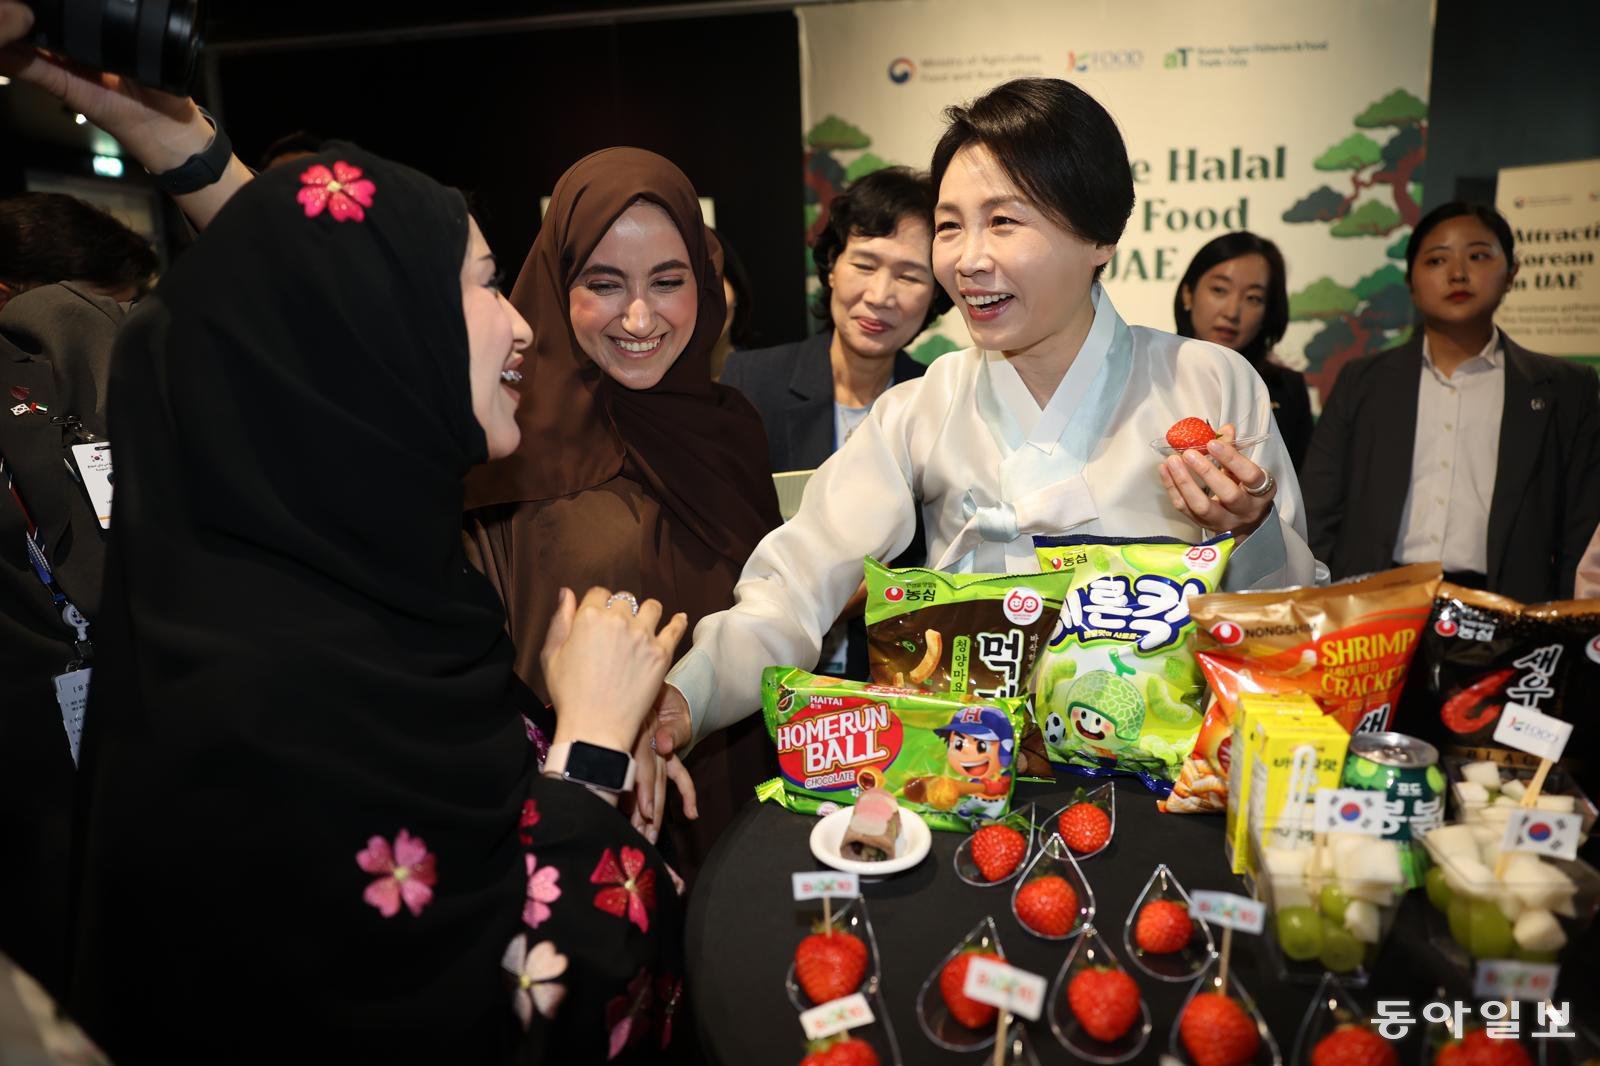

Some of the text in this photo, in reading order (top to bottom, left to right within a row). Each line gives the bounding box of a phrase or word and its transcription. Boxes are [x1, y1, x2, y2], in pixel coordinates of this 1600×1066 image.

[1167, 146, 1286, 182] Halal
[1142, 197, 1248, 232] Food
[1535, 272, 1584, 291] UAE
[1063, 553, 1088, 567] 농심
[906, 589, 936, 602] 농심
[1457, 623, 1495, 642] 농심
[1321, 628, 1417, 667] SHRIMP
[809, 695, 843, 706] HAITAI
[777, 704, 888, 751] HOMERUN
[805, 730, 887, 773] BALL
[804, 770, 855, 789] CHOCOLATE
